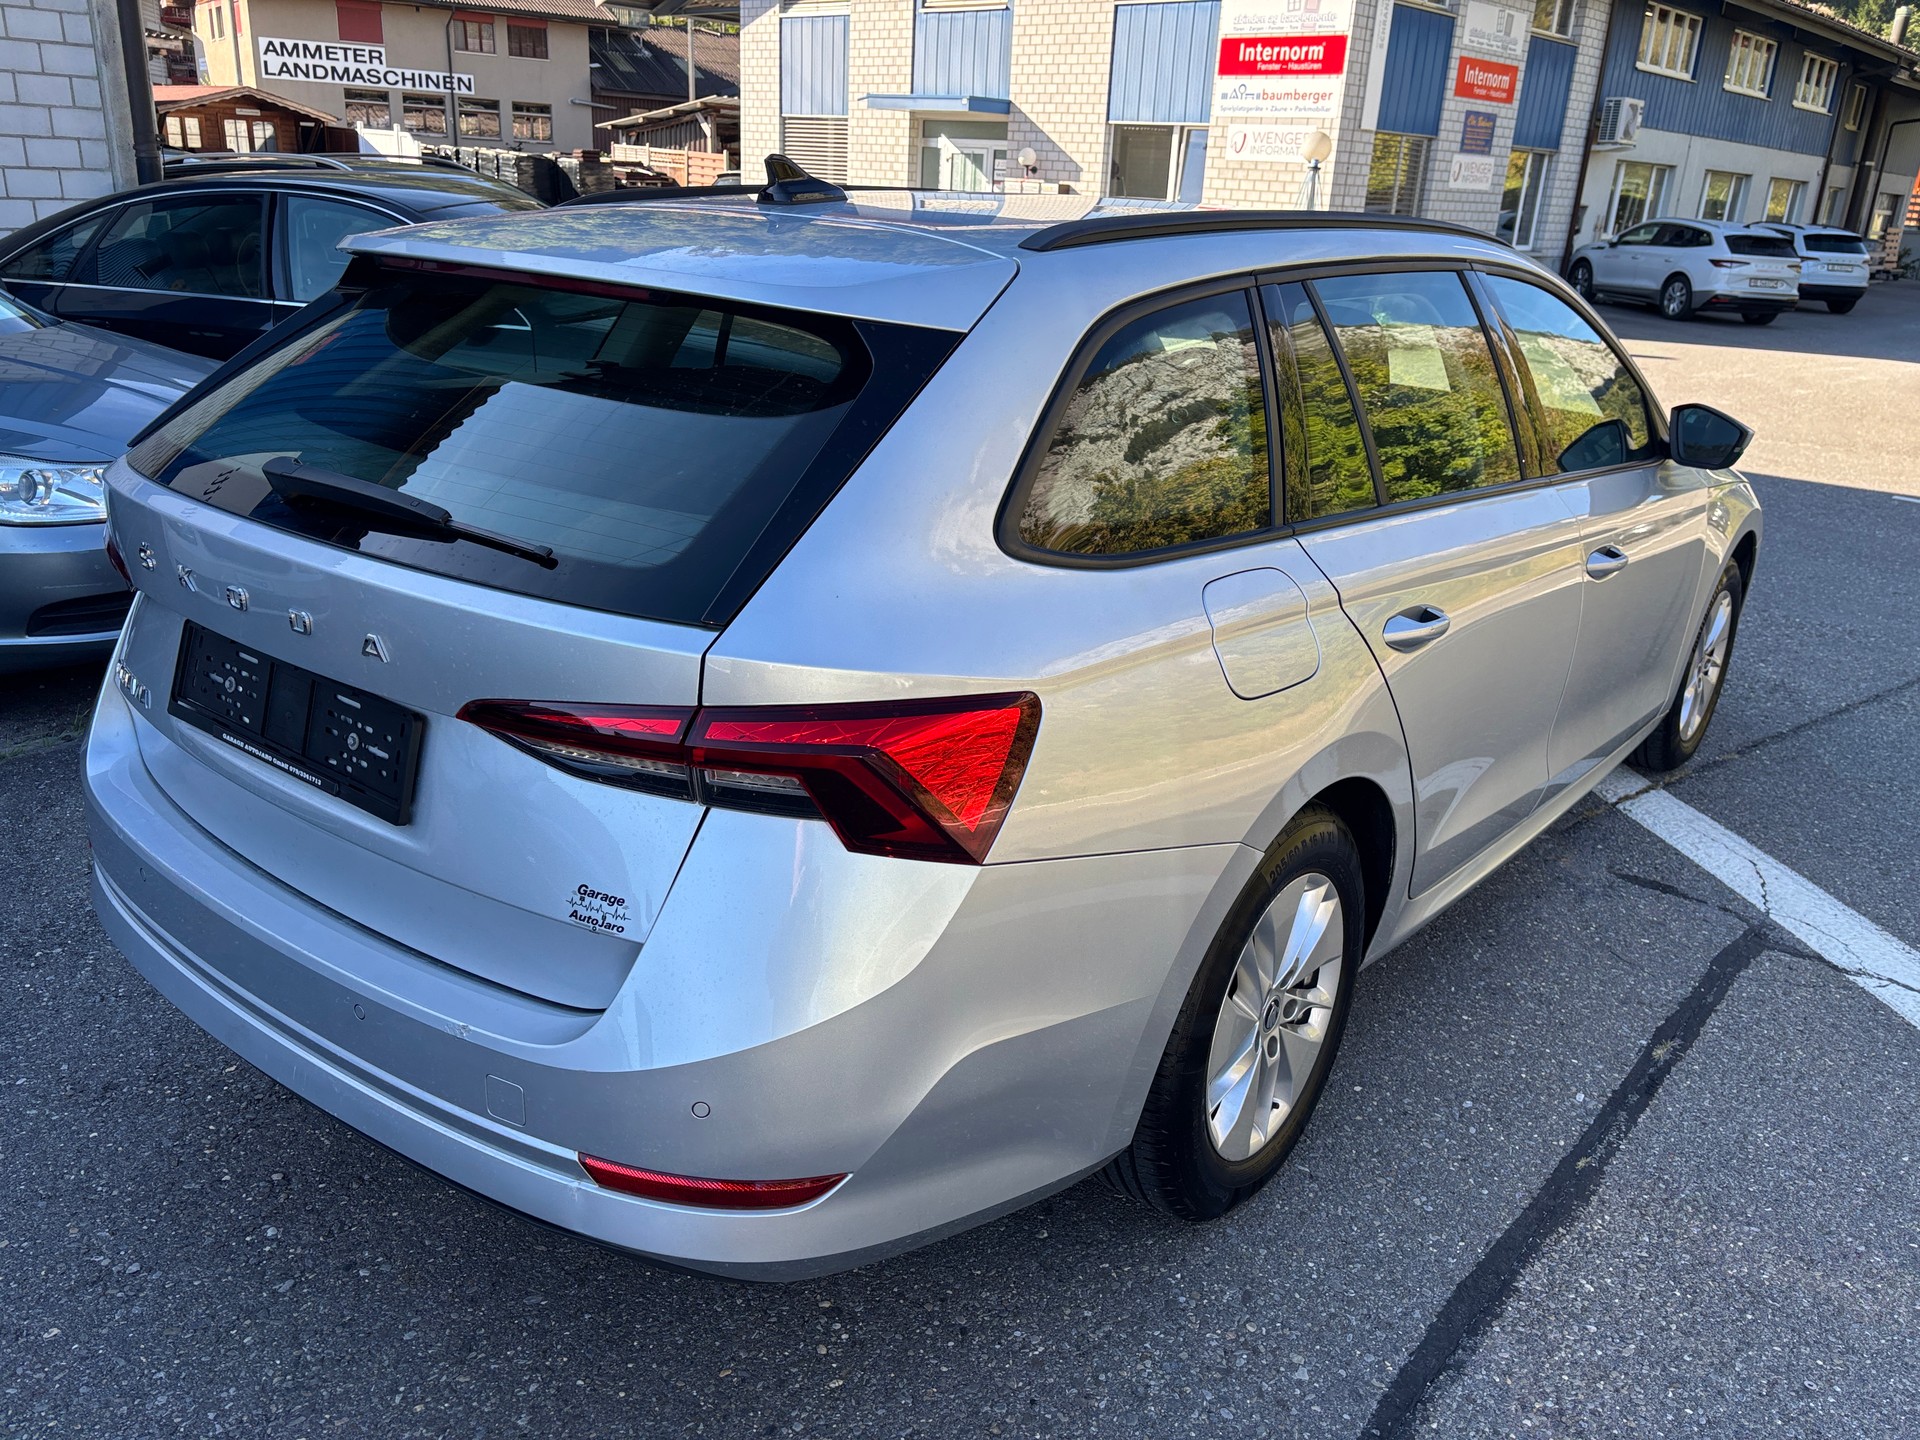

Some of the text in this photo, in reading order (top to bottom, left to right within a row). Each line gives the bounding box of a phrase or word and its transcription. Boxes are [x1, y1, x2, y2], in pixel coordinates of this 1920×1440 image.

[262, 40, 384, 65] AMMETER
[1239, 42, 1325, 62] Internorm
[263, 60, 473, 92] LANDMASCHINEN
[1257, 62, 1322, 71] Fenster Haustüren
[1464, 64, 1511, 90] Internorm
[1261, 88, 1334, 104] baumberger
[577, 883, 625, 907] Garage
[568, 909, 625, 933] AutoJaro
